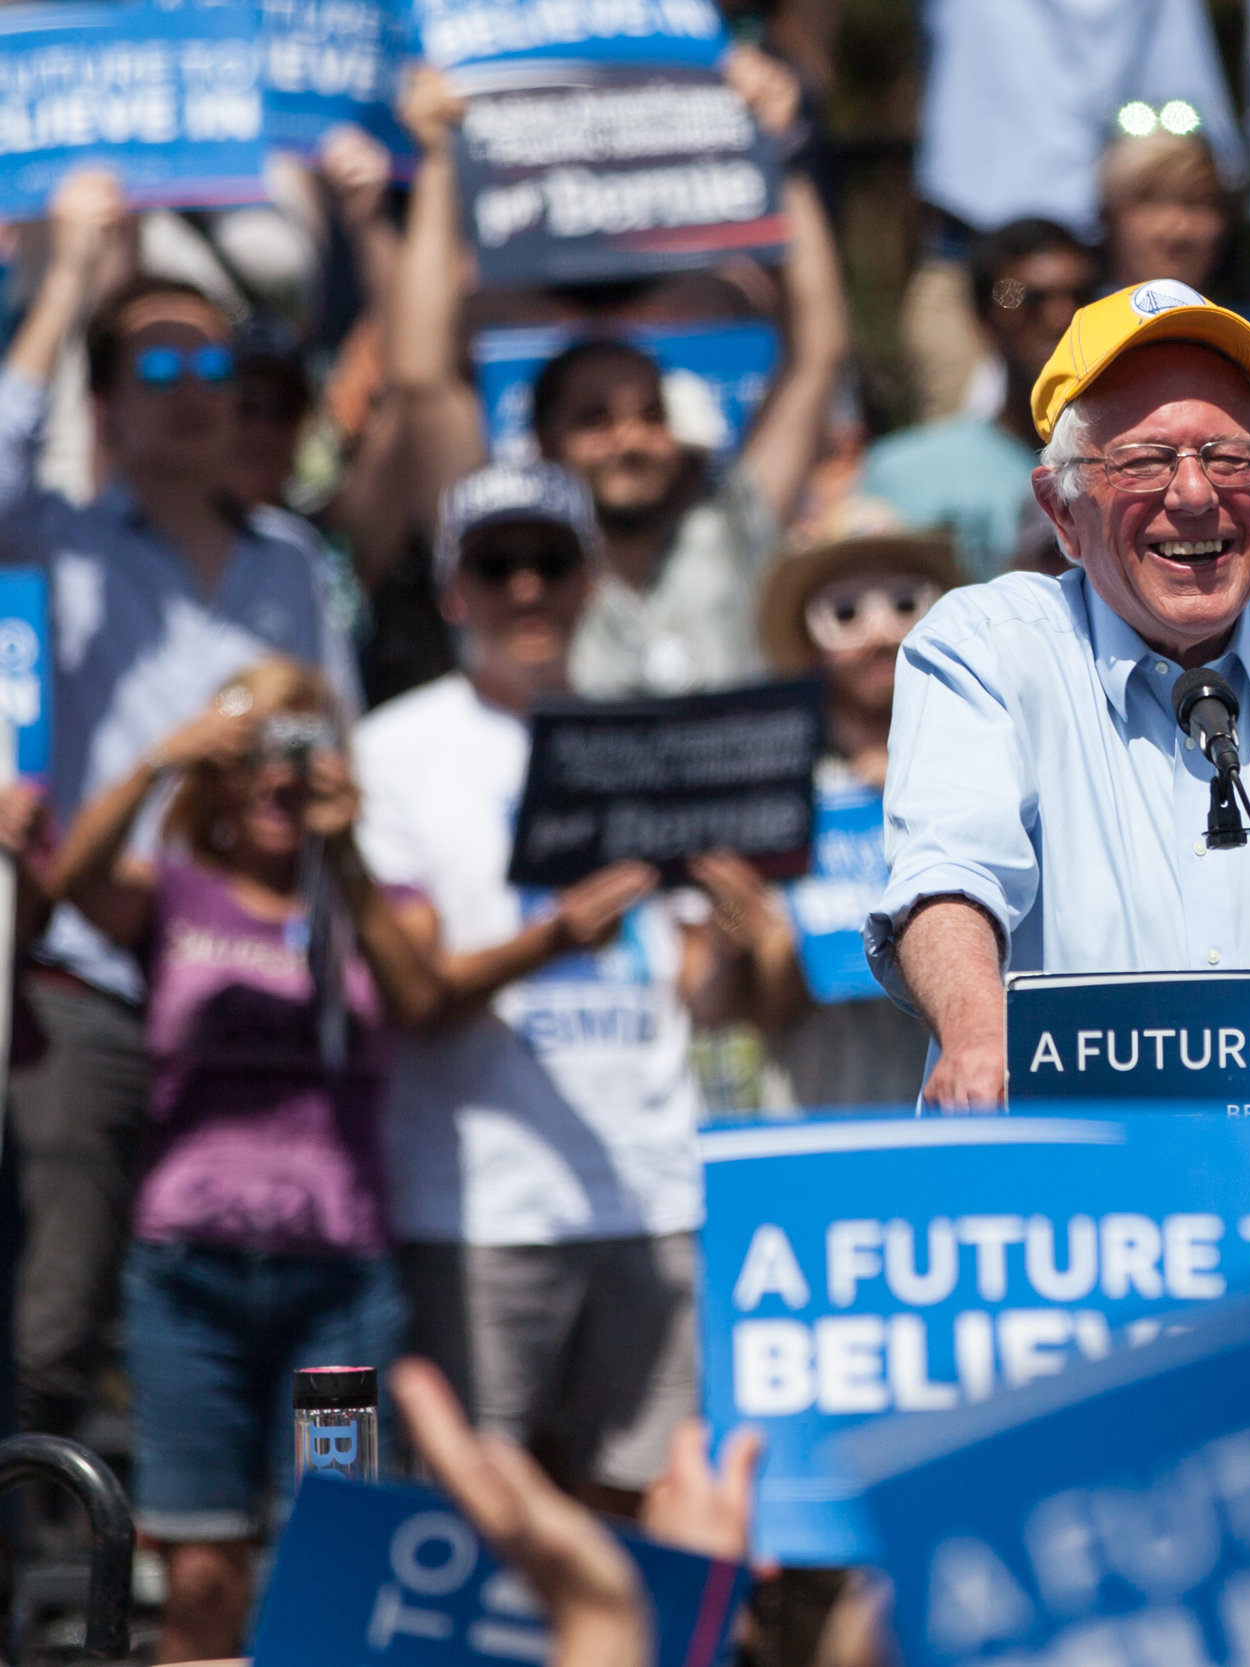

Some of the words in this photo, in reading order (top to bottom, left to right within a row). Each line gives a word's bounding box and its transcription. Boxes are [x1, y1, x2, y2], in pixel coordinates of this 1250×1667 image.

[1030, 1032, 1064, 1072] A
[732, 1221, 810, 1314] A
[825, 1212, 1228, 1307] FUTURE
[364, 1508, 480, 1655] TO
